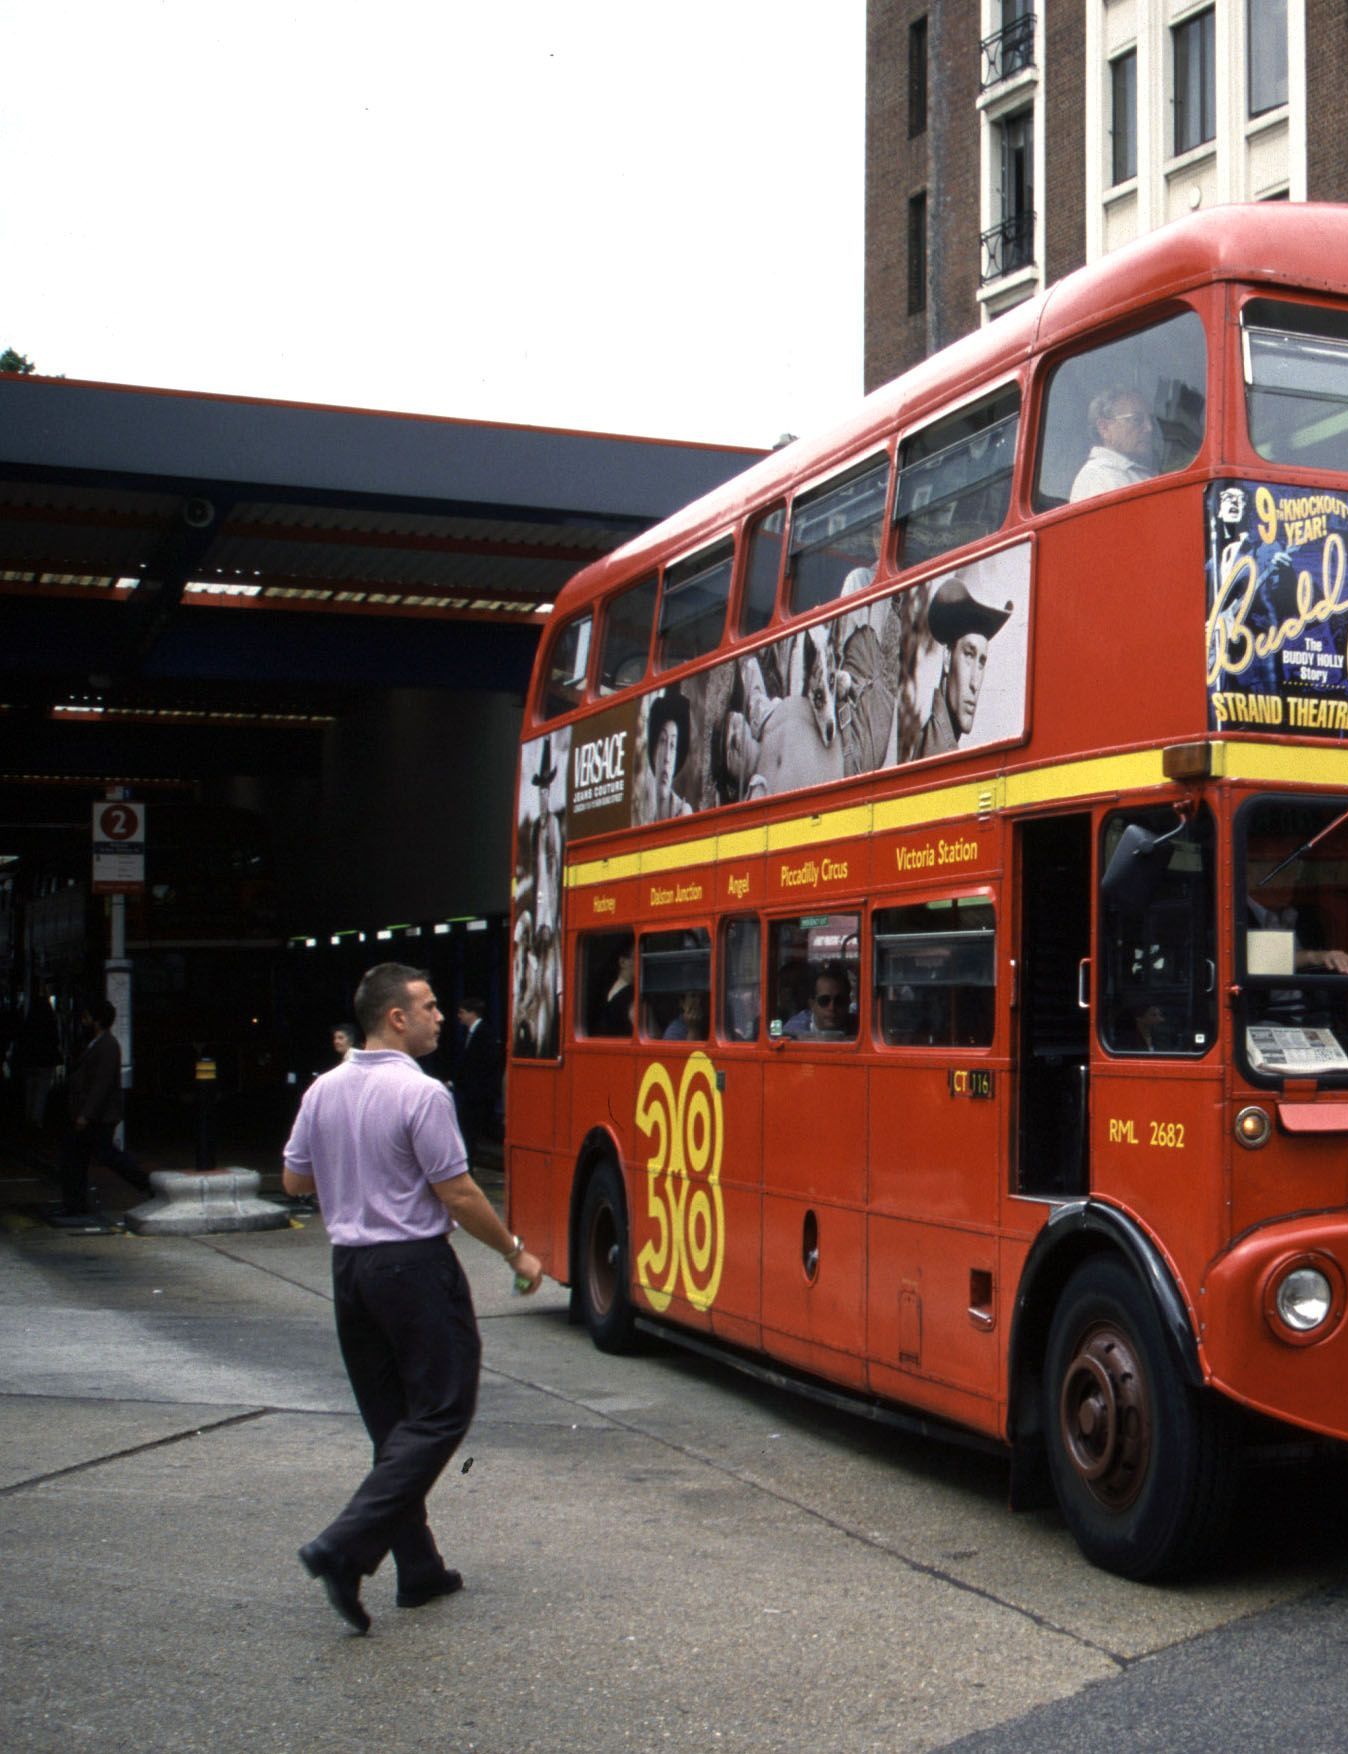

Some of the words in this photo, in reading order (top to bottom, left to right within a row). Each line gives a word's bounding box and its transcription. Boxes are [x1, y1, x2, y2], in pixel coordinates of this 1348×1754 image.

[1284, 515, 1328, 547] YEAR!
[1305, 637, 1322, 652] The
[1282, 650, 1314, 667] BUDDY
[1317, 652, 1344, 668] HOLLY
[1300, 666, 1328, 683] Story
[1211, 692, 1283, 725] STRAND
[574, 731, 627, 789] VERSACE
[111, 809, 127, 833] 2
[896, 843, 935, 871] Victoria
[938, 837, 978, 865] Station
[727, 872, 750, 899] Angel
[781, 859, 818, 888] Piccadilly
[821, 858, 848, 881] Circus
[650, 886, 674, 907] Dalston
[675, 882, 703, 903] Junction
[953, 1070, 968, 1092] CT
[972, 1072, 989, 1094] 116
[1109, 1118, 1139, 1145] RML
[1149, 1121, 1185, 1148] 2682
[635, 1051, 726, 1312] 38
